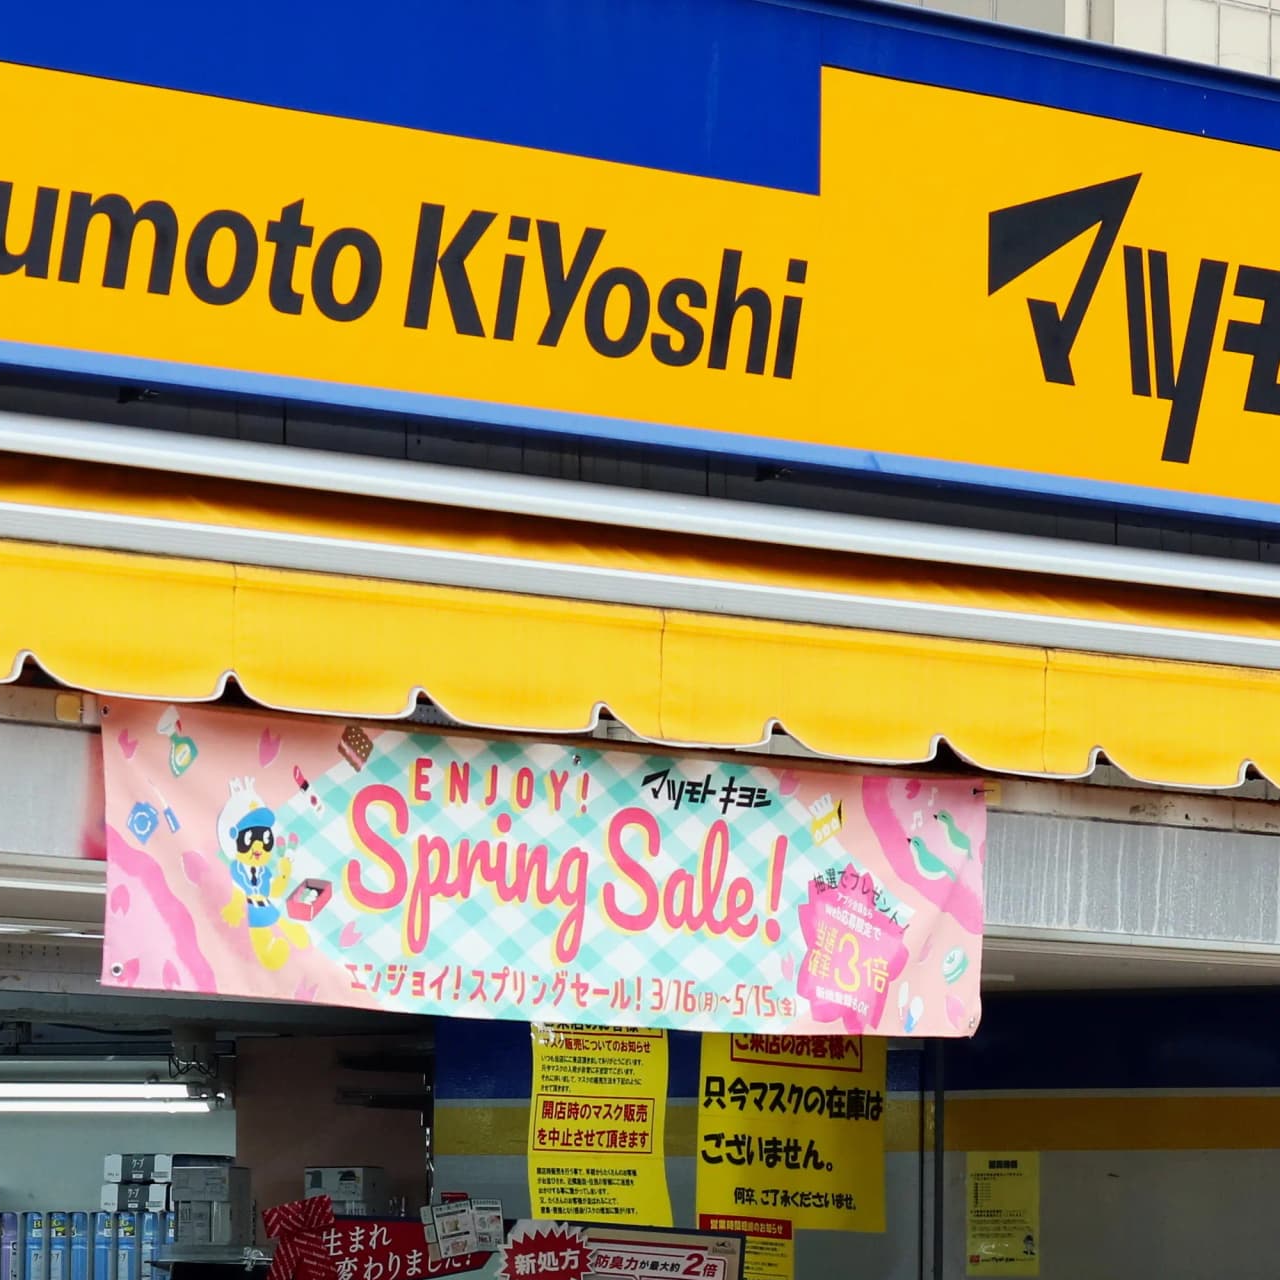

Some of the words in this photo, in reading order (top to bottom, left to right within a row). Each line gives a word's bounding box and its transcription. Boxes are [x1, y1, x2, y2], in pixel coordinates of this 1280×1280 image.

[403, 203, 808, 380] KiYoshi
[408, 757, 591, 816] ENJOY!
[641, 770, 773, 812] マツモトキヨシ
[342, 783, 587, 965] Spring
[603, 807, 789, 942] Sale!
[542, 1100, 648, 1122] 開店時のマスク販売
[703, 1076, 883, 1121] 只今マスクの在庫は
[537, 1128, 649, 1148] を中止させて頂きます
[701, 1132, 833, 1171] ございません。
[323, 1224, 392, 1257] 生まれ
[515, 1248, 581, 1275] 新処方
